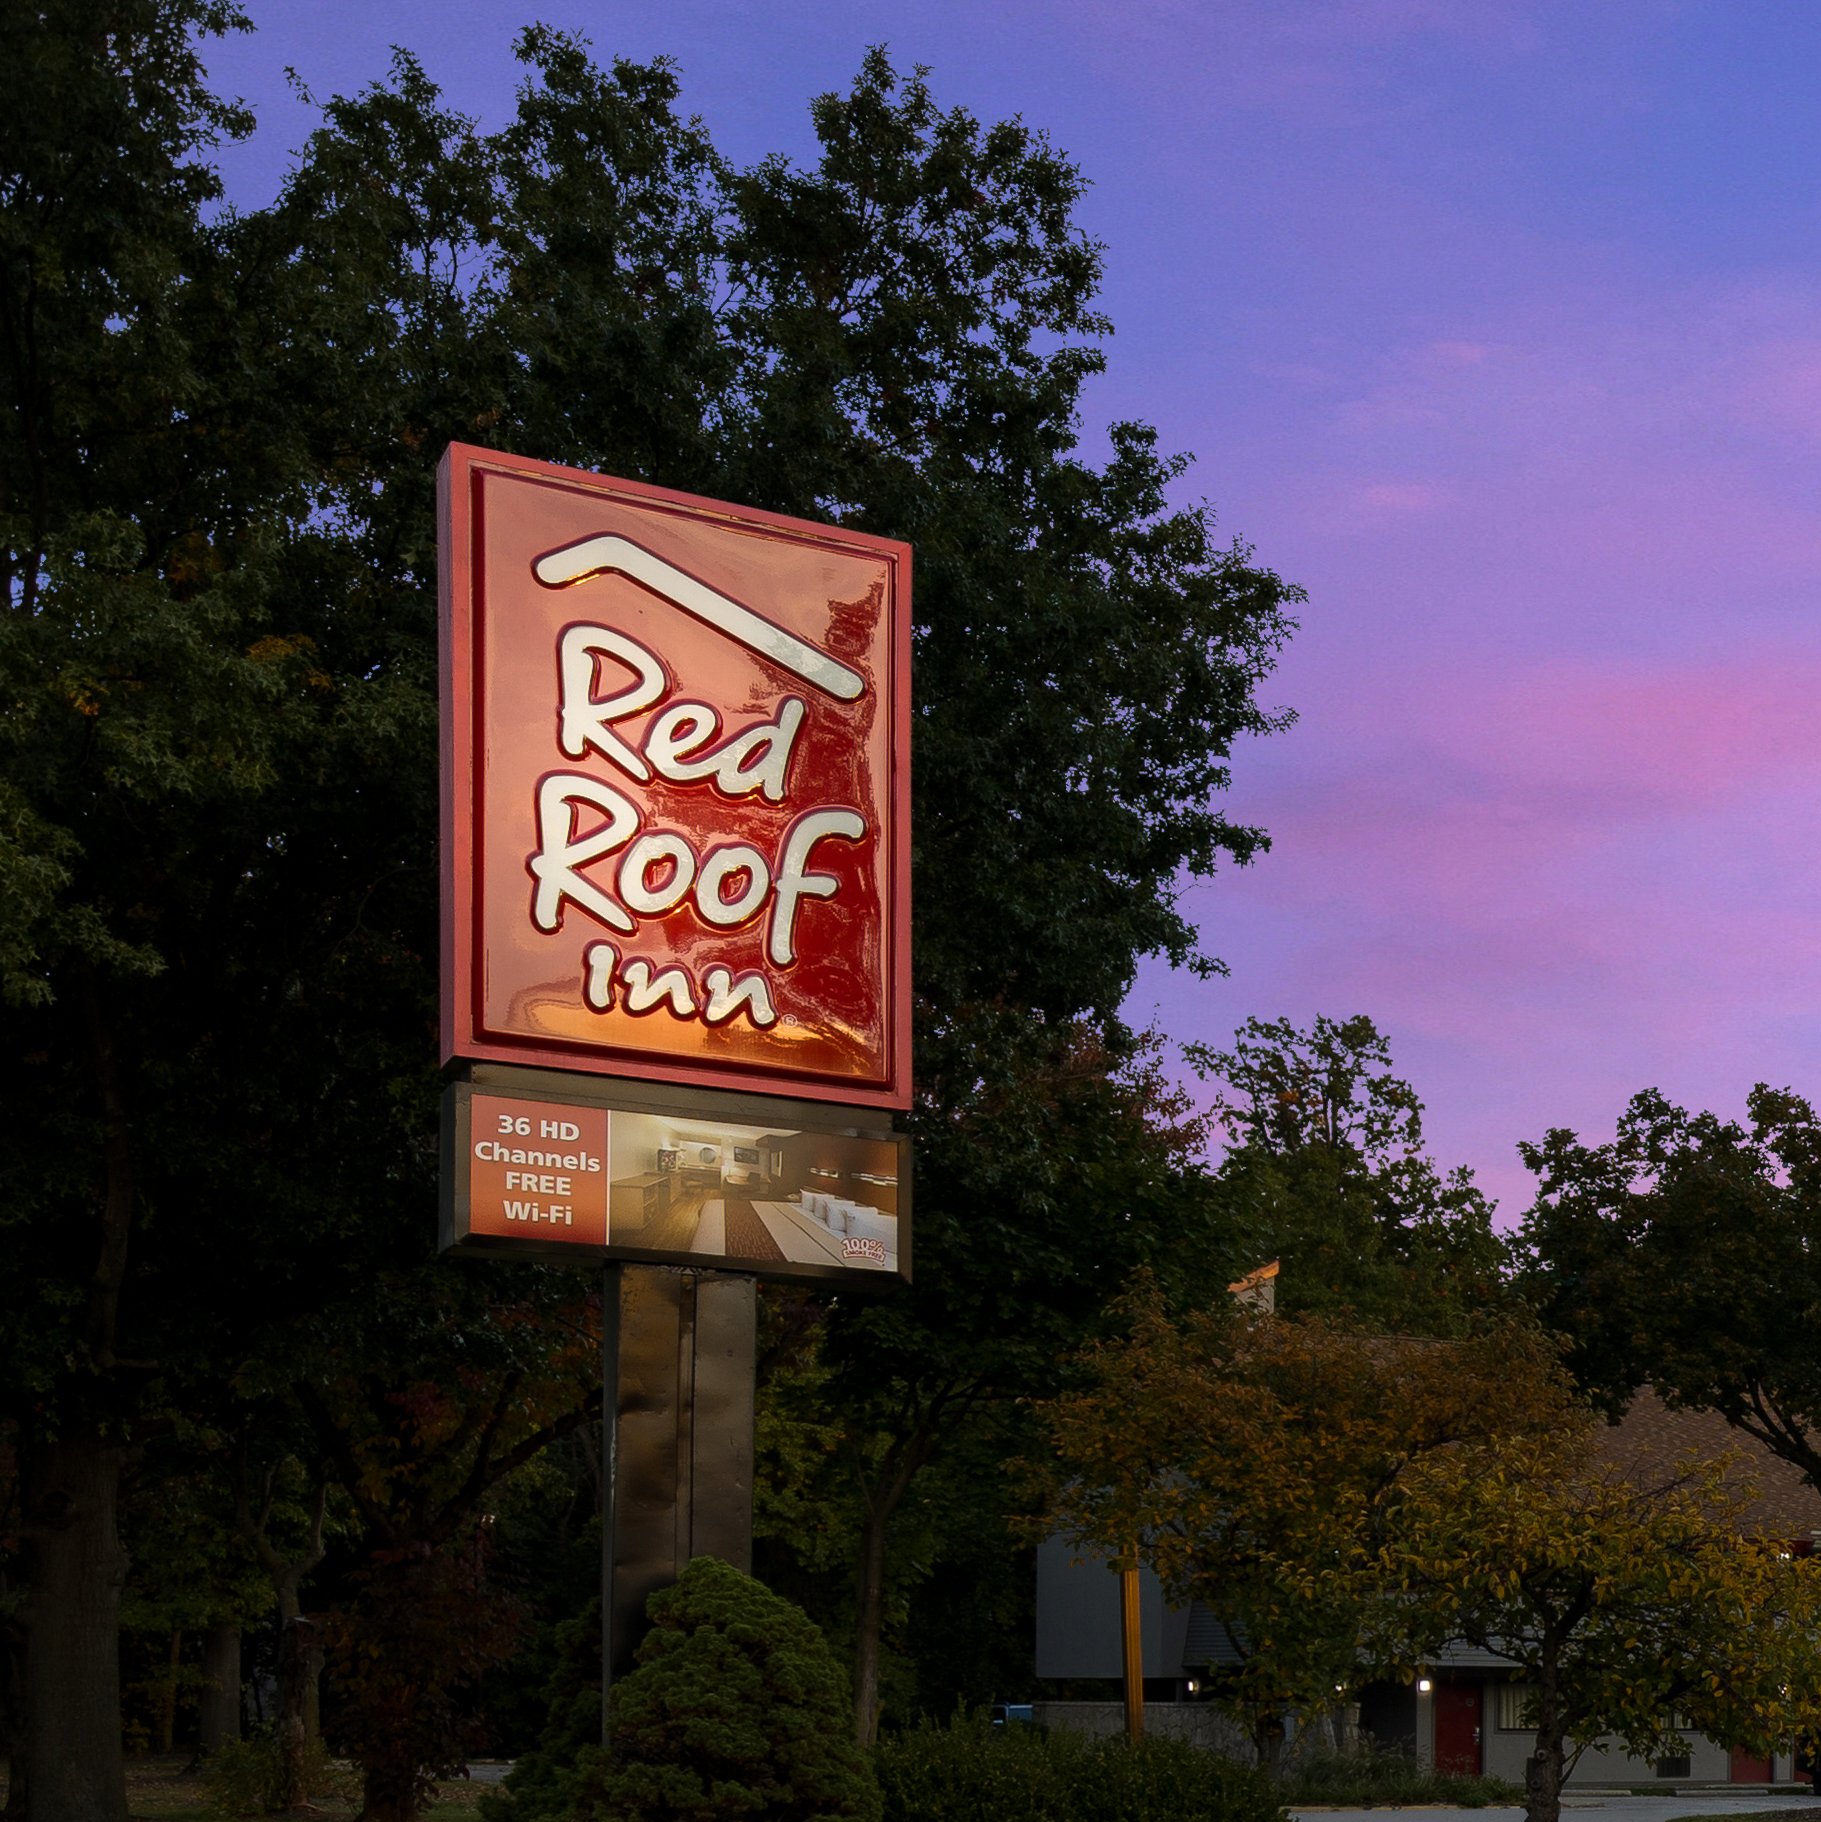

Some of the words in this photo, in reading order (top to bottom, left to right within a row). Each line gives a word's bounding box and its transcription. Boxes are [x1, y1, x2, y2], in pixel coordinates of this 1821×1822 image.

[559, 624, 806, 801] Red
[530, 773, 865, 965] Roof
[587, 944, 778, 1025] Inn
[497, 1114, 531, 1136] 36
[540, 1119, 580, 1141] HD
[474, 1141, 601, 1172] Channels
[505, 1171, 571, 1196] FREE
[502, 1199, 572, 1225] Wi-Fi
[841, 1238, 884, 1254] 100%
